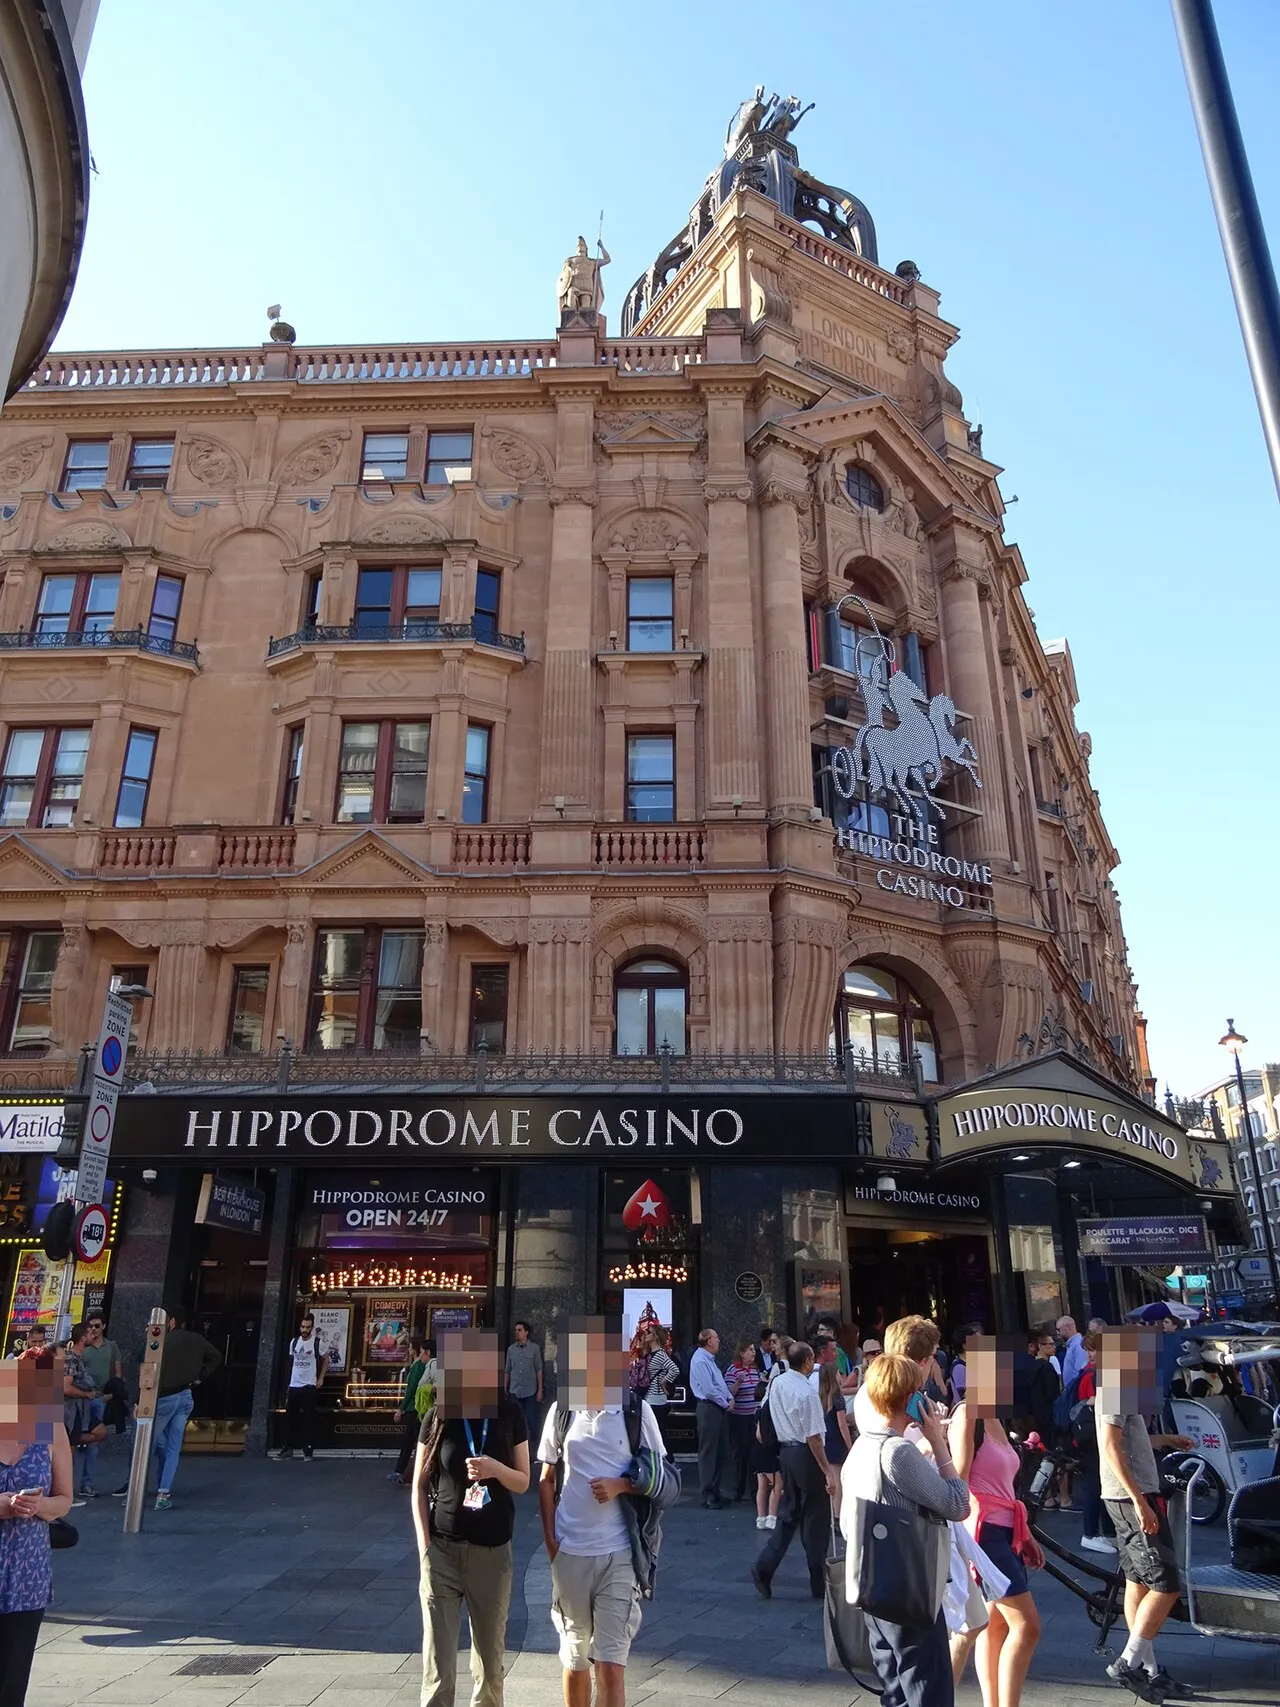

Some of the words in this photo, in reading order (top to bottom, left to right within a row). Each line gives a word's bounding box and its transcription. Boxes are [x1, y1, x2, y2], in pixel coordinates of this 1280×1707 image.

[810, 310, 878, 363] LONDON
[892, 814, 938, 845] THE
[838, 826, 993, 885] HIPPODROME
[876, 868, 964, 907] CASINO
[107, 994, 132, 1015] Restricted
[106, 1019, 126, 1037] ZONE
[96, 1090, 113, 1104] ZONE
[0, 1113, 63, 1140] Matild
[184, 1109, 531, 1147] HIPPODROME
[548, 1109, 744, 1147] CASINO
[953, 1103, 1098, 1137] HIPPODROME
[1101, 1113, 1178, 1160] CASINO
[937, 1193, 981, 1208] CASINO
[227, 1207, 251, 1223] LONDON
[346, 1209, 401, 1226] OPEN
[406, 1209, 449, 1226] 24/7
[1086, 1228, 1125, 1236] ROULETTE
[1129, 1226, 1175, 1235] BLACKJACK
[1178, 1226, 1198, 1234] DICE
[1090, 1236, 1131, 1245] BACCARAT
[311, 1267, 473, 1294] HIPPODROME
[609, 1262, 688, 1283] CASINO
[374, 1301, 407, 1310] COMEDY
